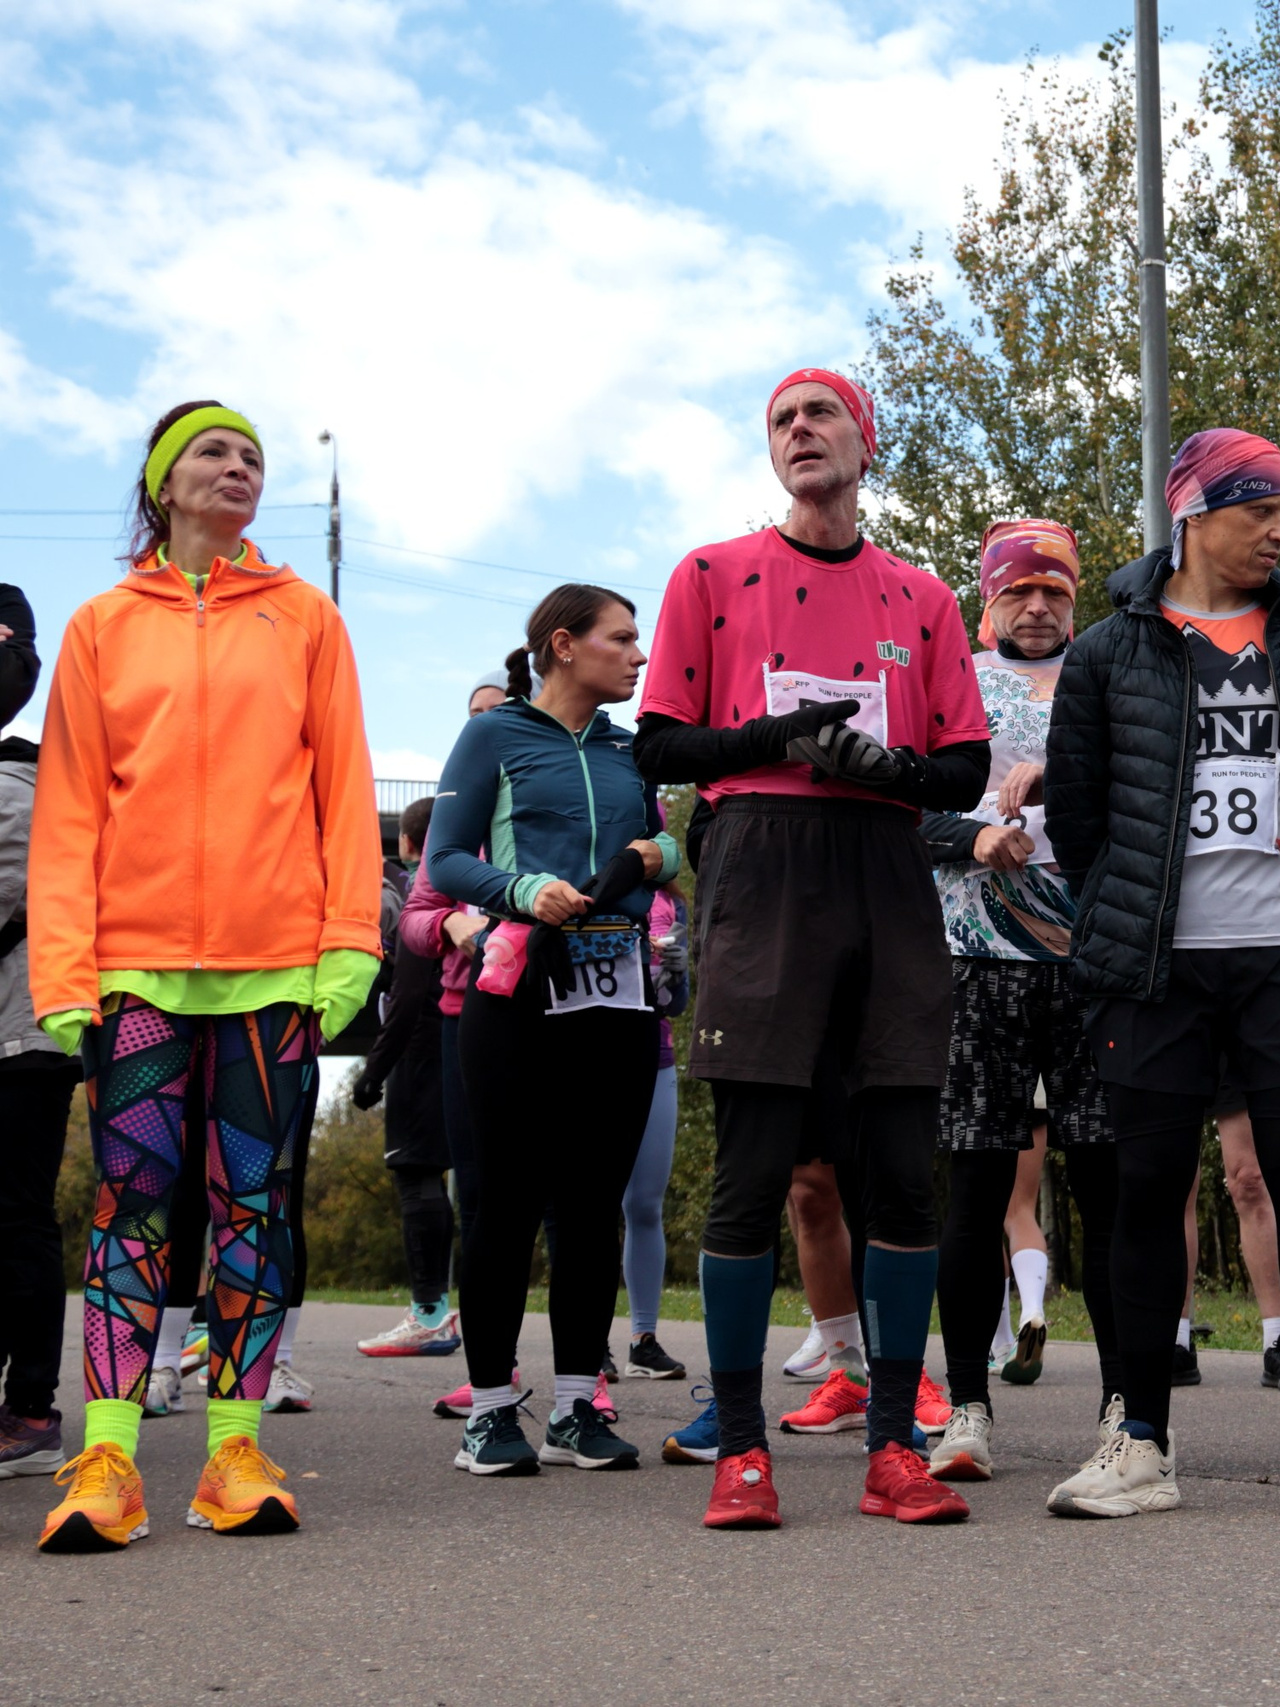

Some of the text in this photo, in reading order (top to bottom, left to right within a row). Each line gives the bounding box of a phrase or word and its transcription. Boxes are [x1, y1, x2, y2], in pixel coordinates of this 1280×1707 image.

[1233, 481, 1272, 491] VENTO
[818, 687, 832, 697] RUN
[1211, 770, 1228, 778] RUN
[1240, 771, 1267, 779] PEOPLE
[1190, 787, 1258, 839] 38
